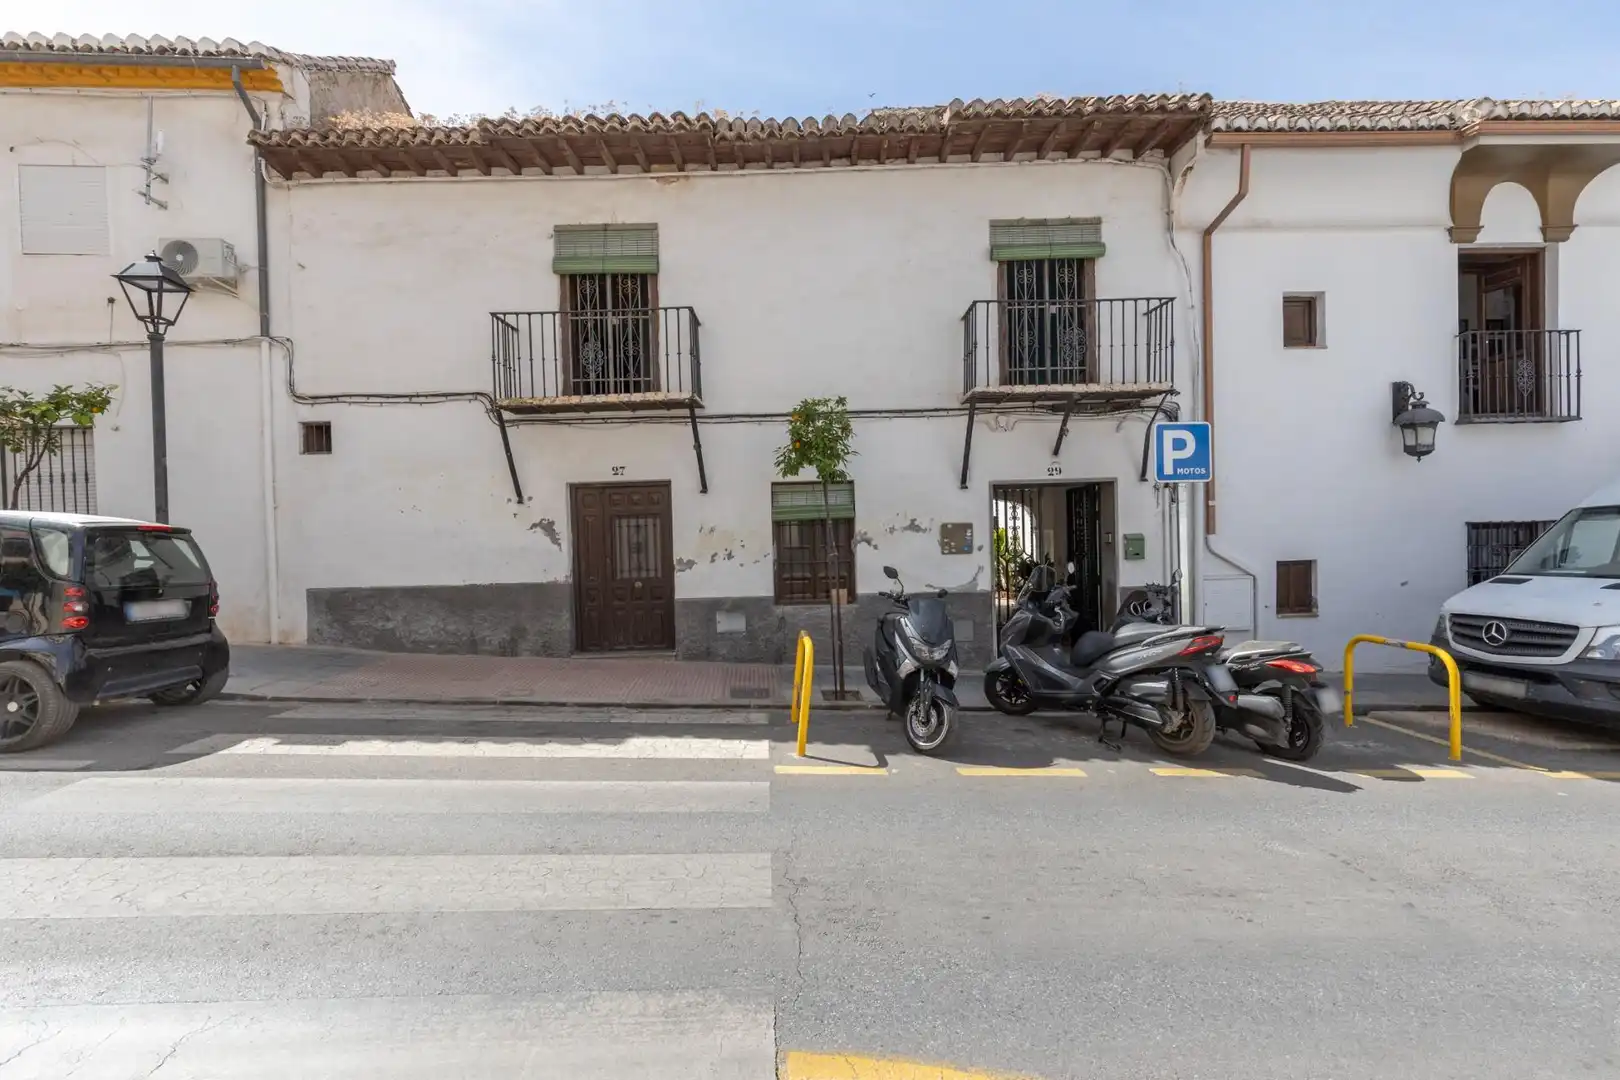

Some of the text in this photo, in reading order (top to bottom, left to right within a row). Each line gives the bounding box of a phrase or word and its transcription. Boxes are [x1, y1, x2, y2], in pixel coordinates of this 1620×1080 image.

[1163, 430, 1196, 475] P
[611, 466, 626, 476] 27
[1047, 466, 1062, 476] 29
[1177, 467, 1206, 475] MOTOS
